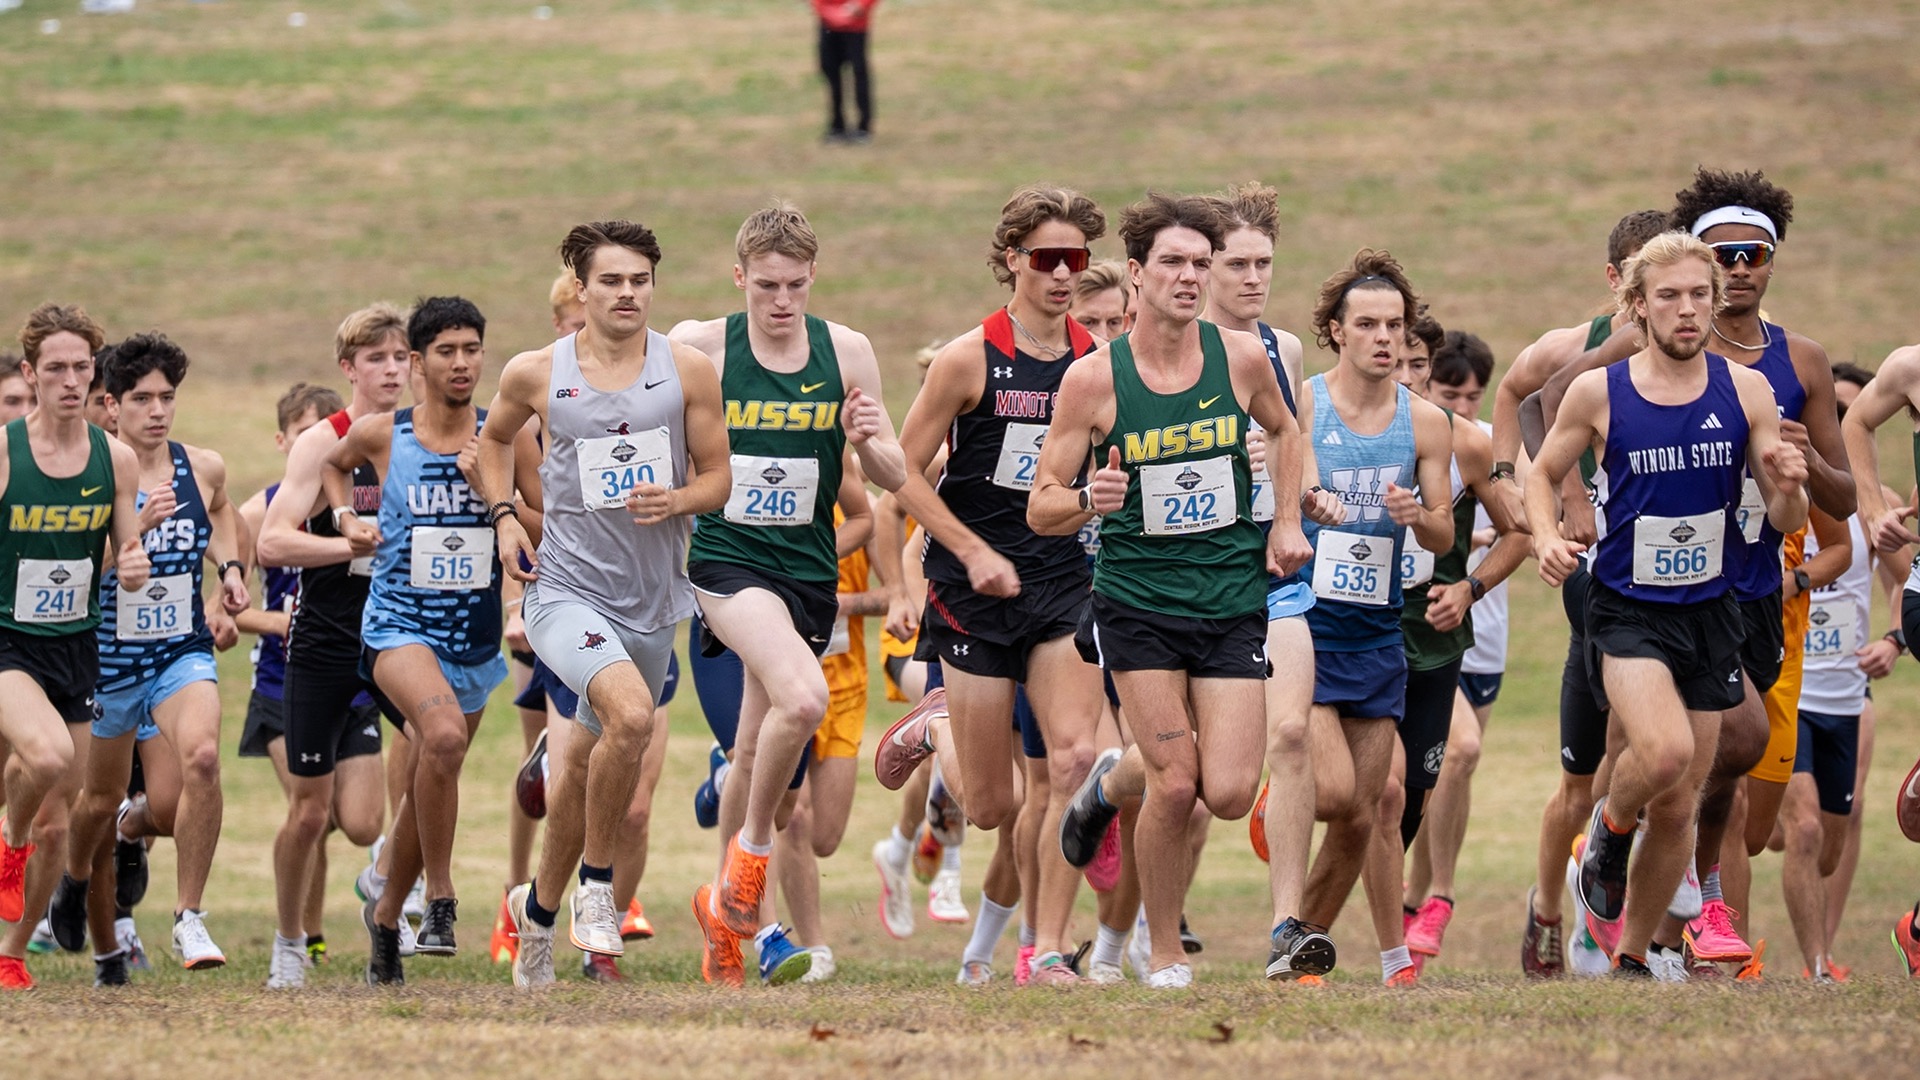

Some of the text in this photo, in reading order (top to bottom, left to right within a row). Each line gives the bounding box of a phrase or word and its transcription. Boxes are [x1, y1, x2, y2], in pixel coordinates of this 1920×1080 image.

[556, 388, 579, 399] GAC
[994, 390, 1049, 418] MINOT
[725, 399, 839, 431] MSSU
[1124, 414, 1237, 464] MSSU
[1628, 441, 1732, 475] WINONA STATE
[601, 464, 655, 498] 340
[407, 483, 489, 515] UAFS
[745, 489, 796, 516] 246
[1164, 492, 1217, 525] 242
[9, 504, 112, 533] MSSU
[430, 556, 473, 580] 515
[1654, 546, 1707, 575] 566
[1332, 563, 1377, 593] 535
[35, 589, 74, 613] 241
[137, 604, 176, 630] 513
